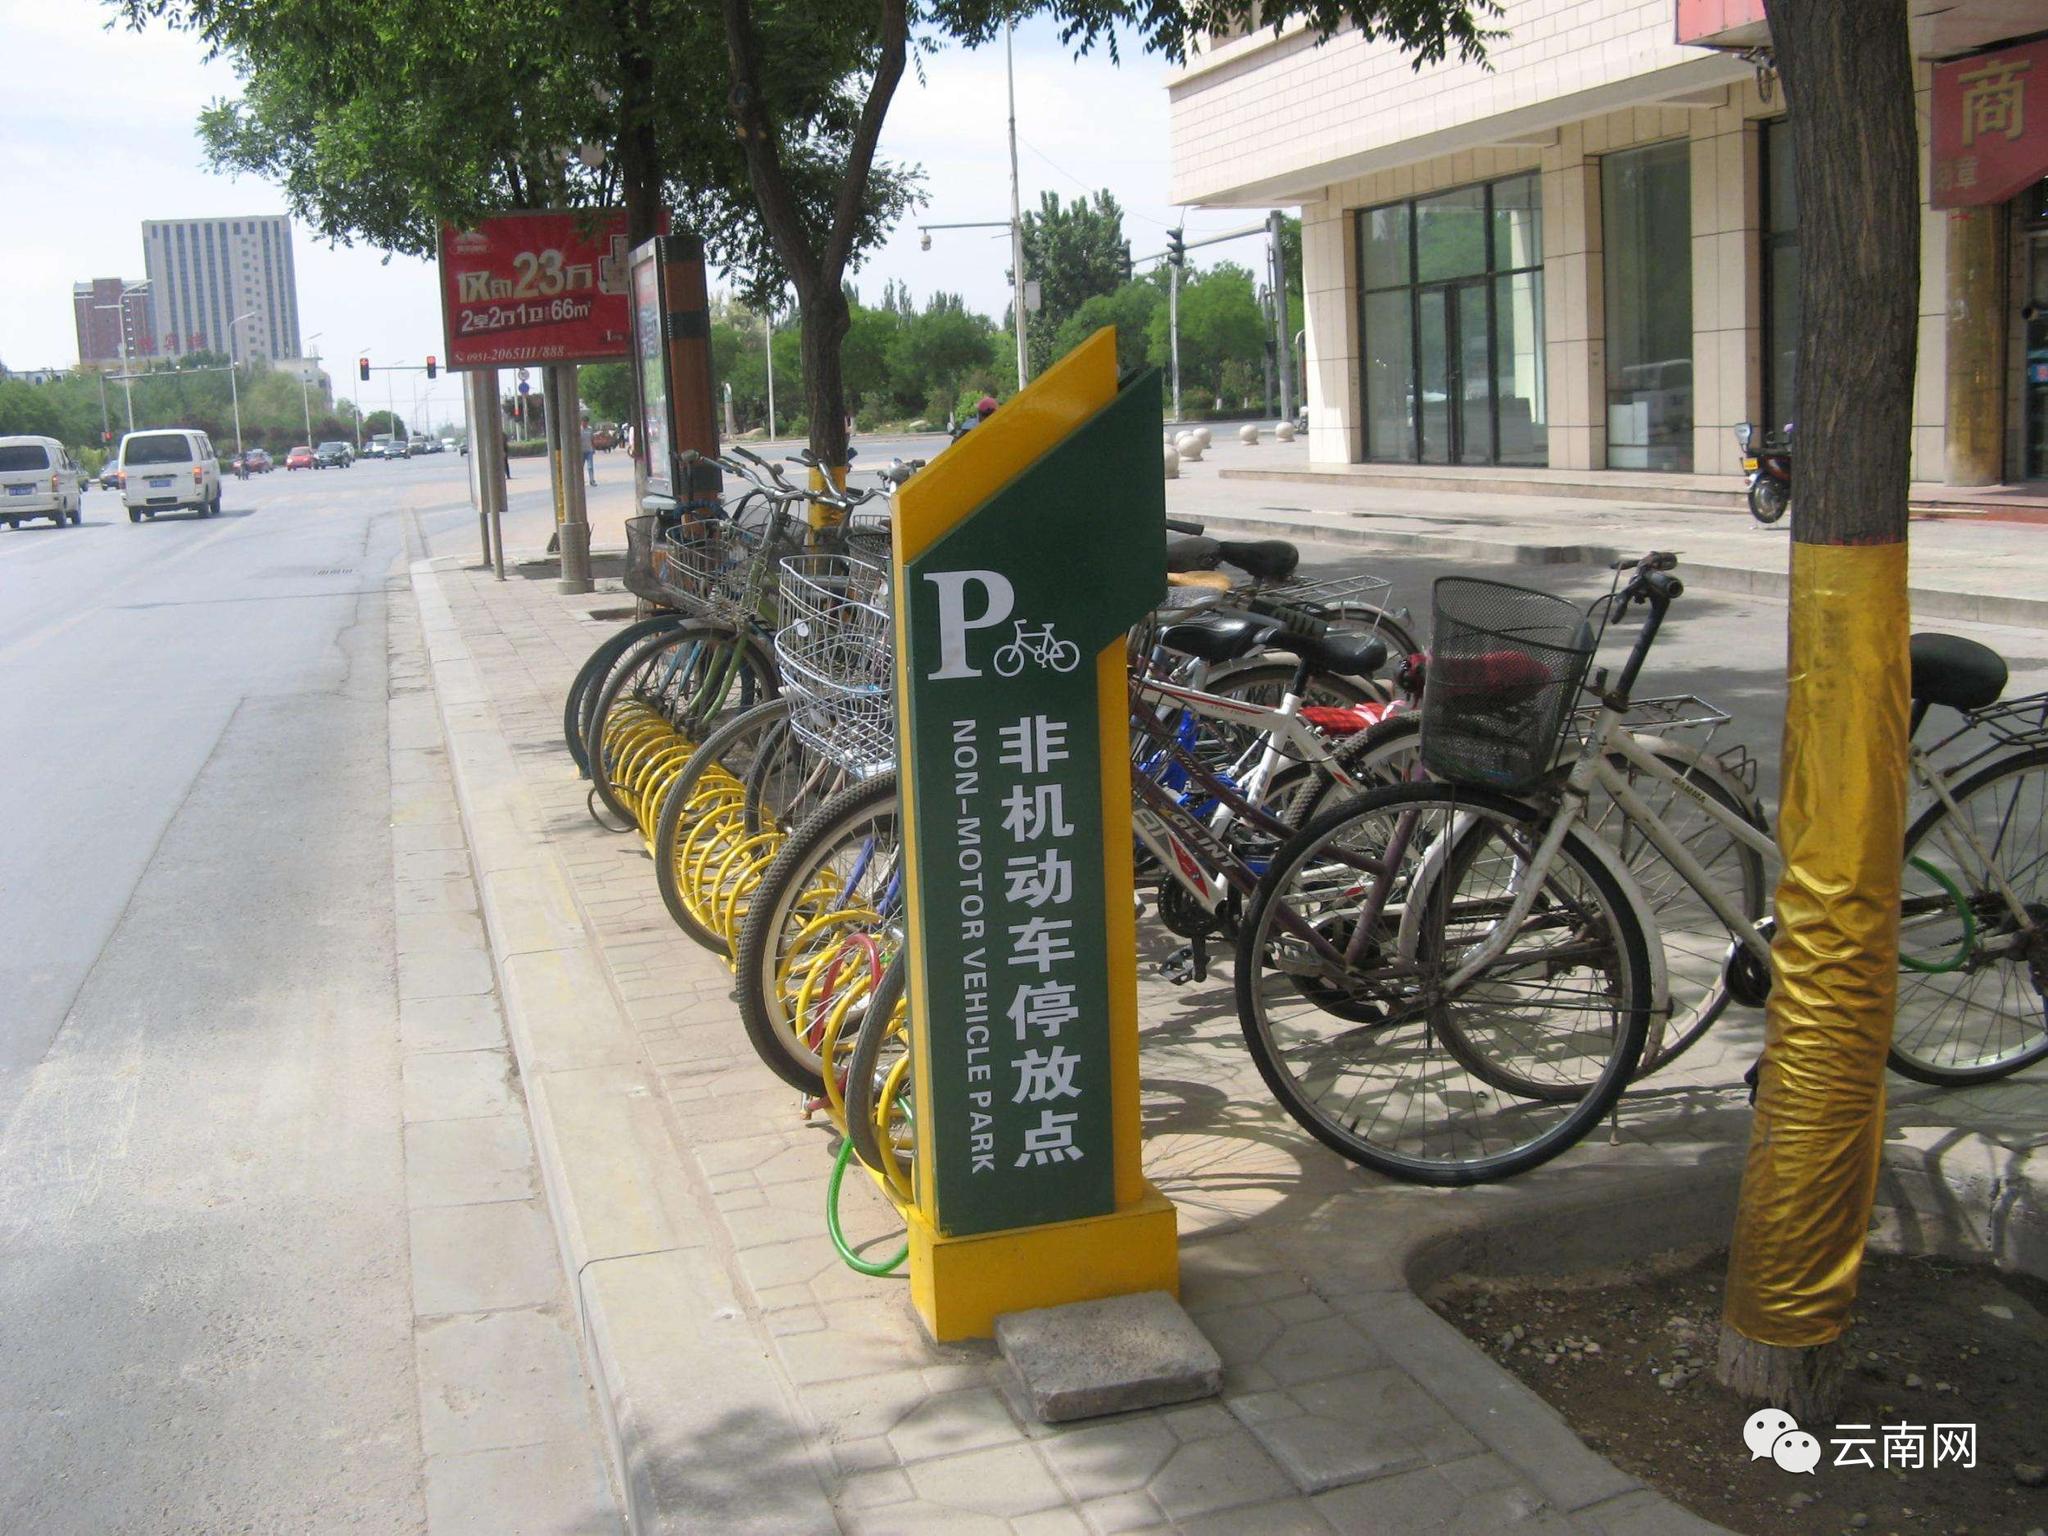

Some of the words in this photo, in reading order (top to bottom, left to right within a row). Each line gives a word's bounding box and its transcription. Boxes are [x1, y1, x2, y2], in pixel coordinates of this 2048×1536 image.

[1957, 59, 2033, 147] 商
[923, 569, 1015, 680] P
[953, 719, 985, 940] NON-MOTOR
[1171, 812, 1240, 868] GLINT
[998, 714, 1084, 1168] 非机动车停放点
[963, 947, 991, 1083] VEHICLE
[968, 1091, 995, 1175] PARK
